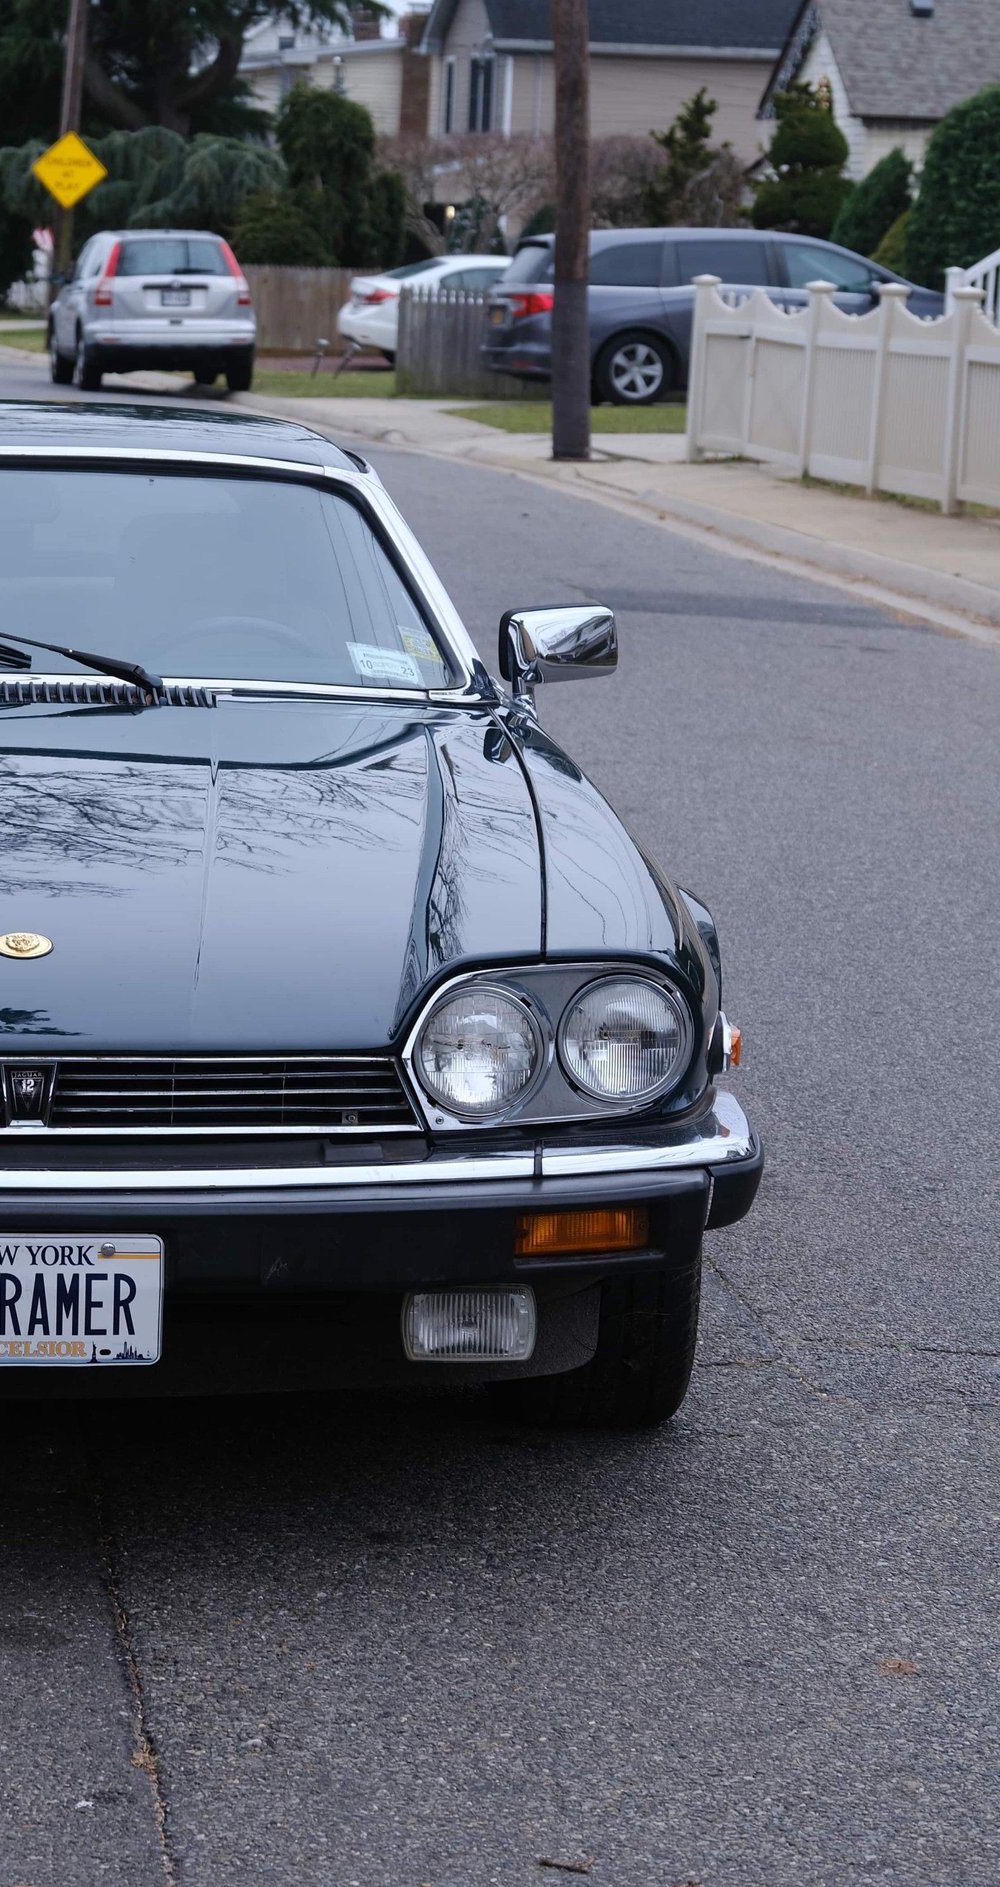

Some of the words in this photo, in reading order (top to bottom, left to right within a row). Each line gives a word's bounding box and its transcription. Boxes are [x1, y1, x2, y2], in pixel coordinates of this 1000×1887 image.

[360, 659, 373, 670] 10
[21, 1079, 35, 1093] 12
[24, 1244, 96, 1267] YORK
